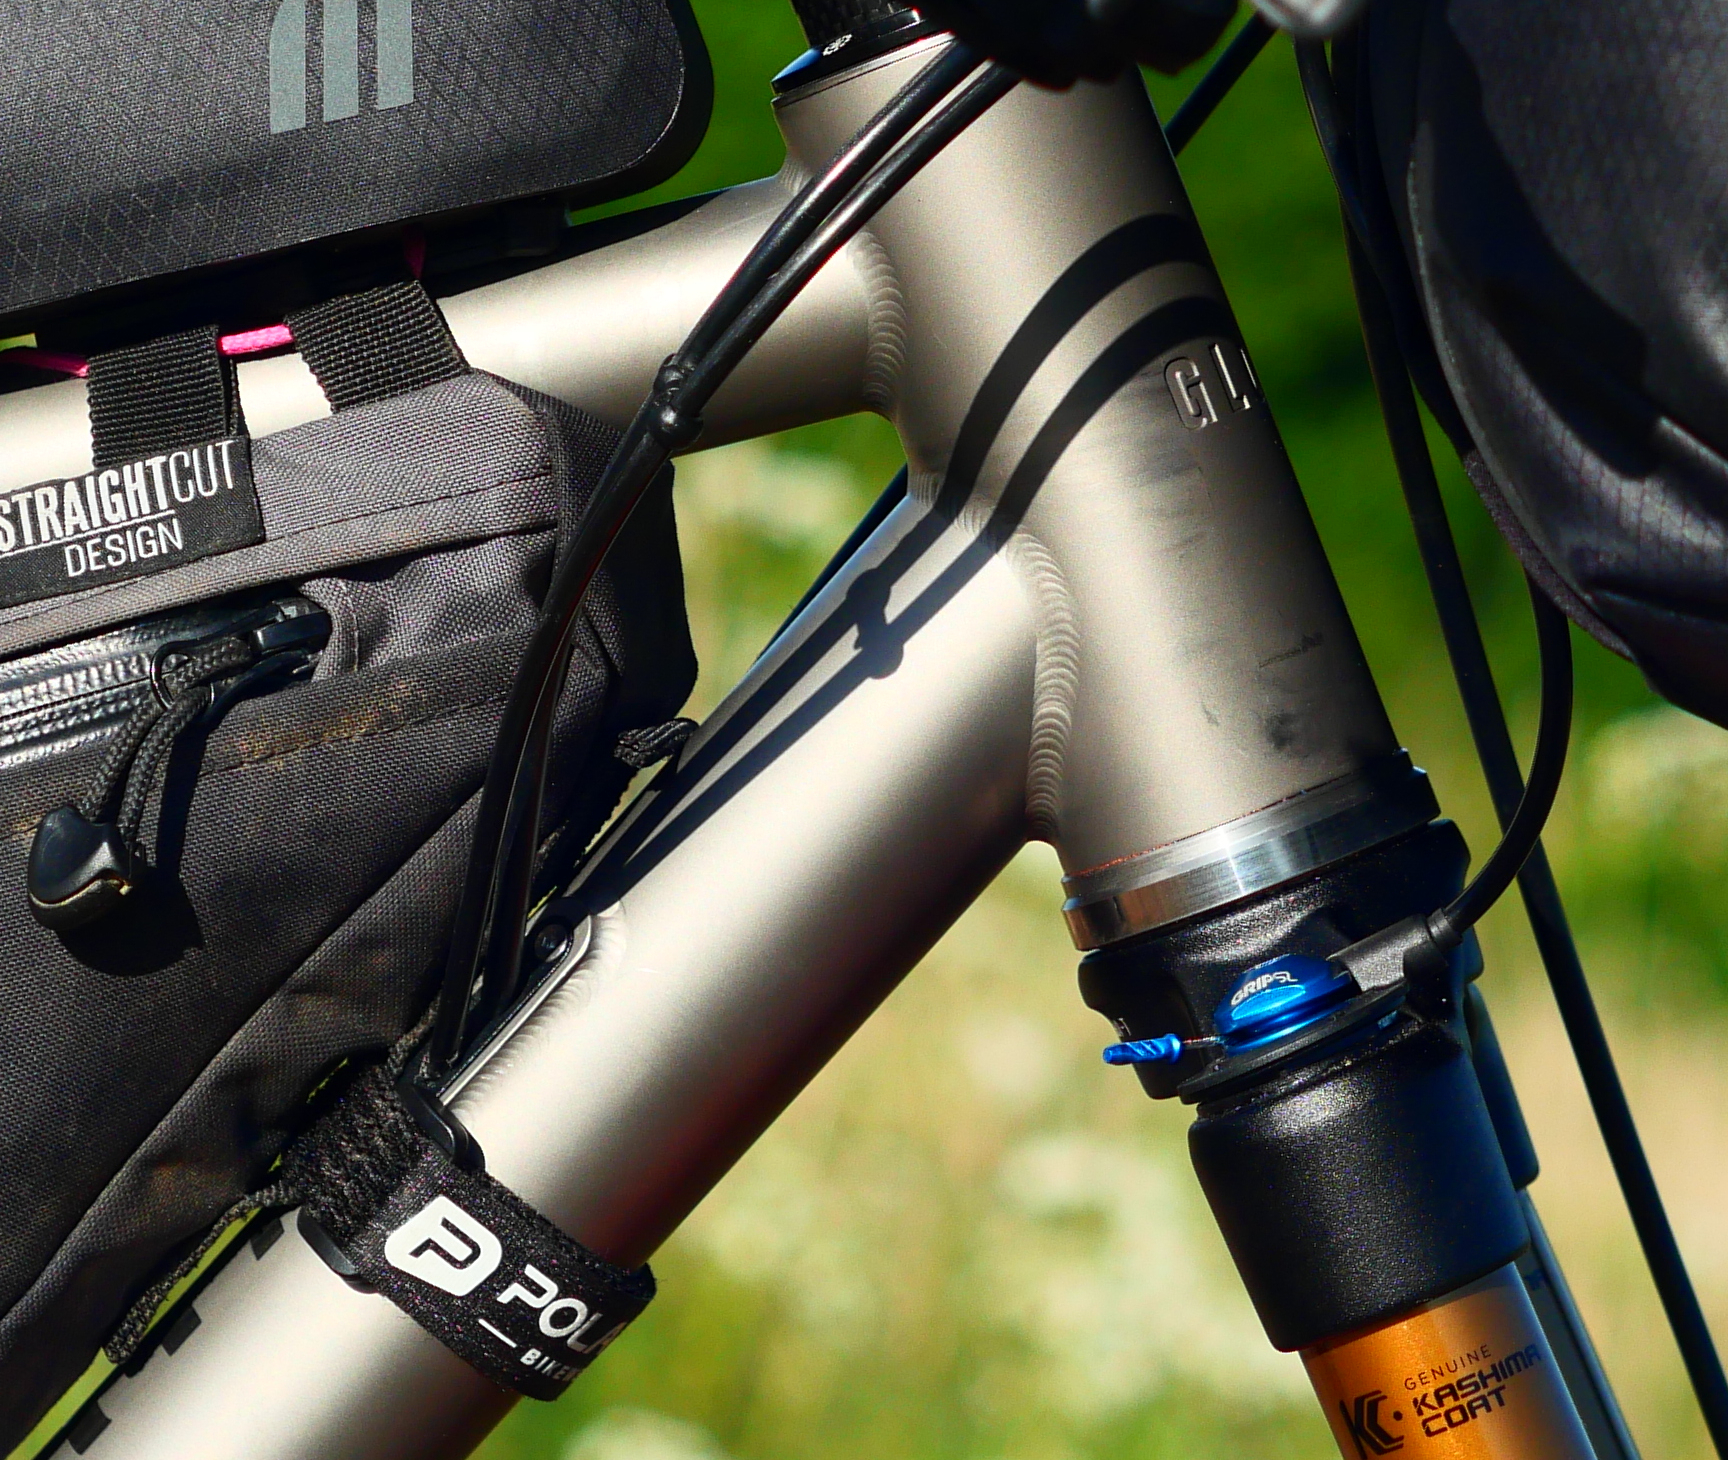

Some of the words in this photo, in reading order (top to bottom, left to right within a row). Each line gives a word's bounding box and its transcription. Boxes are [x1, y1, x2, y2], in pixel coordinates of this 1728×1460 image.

[1164, 343, 1258, 431] GL
[65, 518, 183, 577] DESIGN
[1404, 1344, 1492, 1391] GENUINE
[1412, 1343, 1542, 1417] KASHIMA
[1421, 1385, 1507, 1438] COAT
